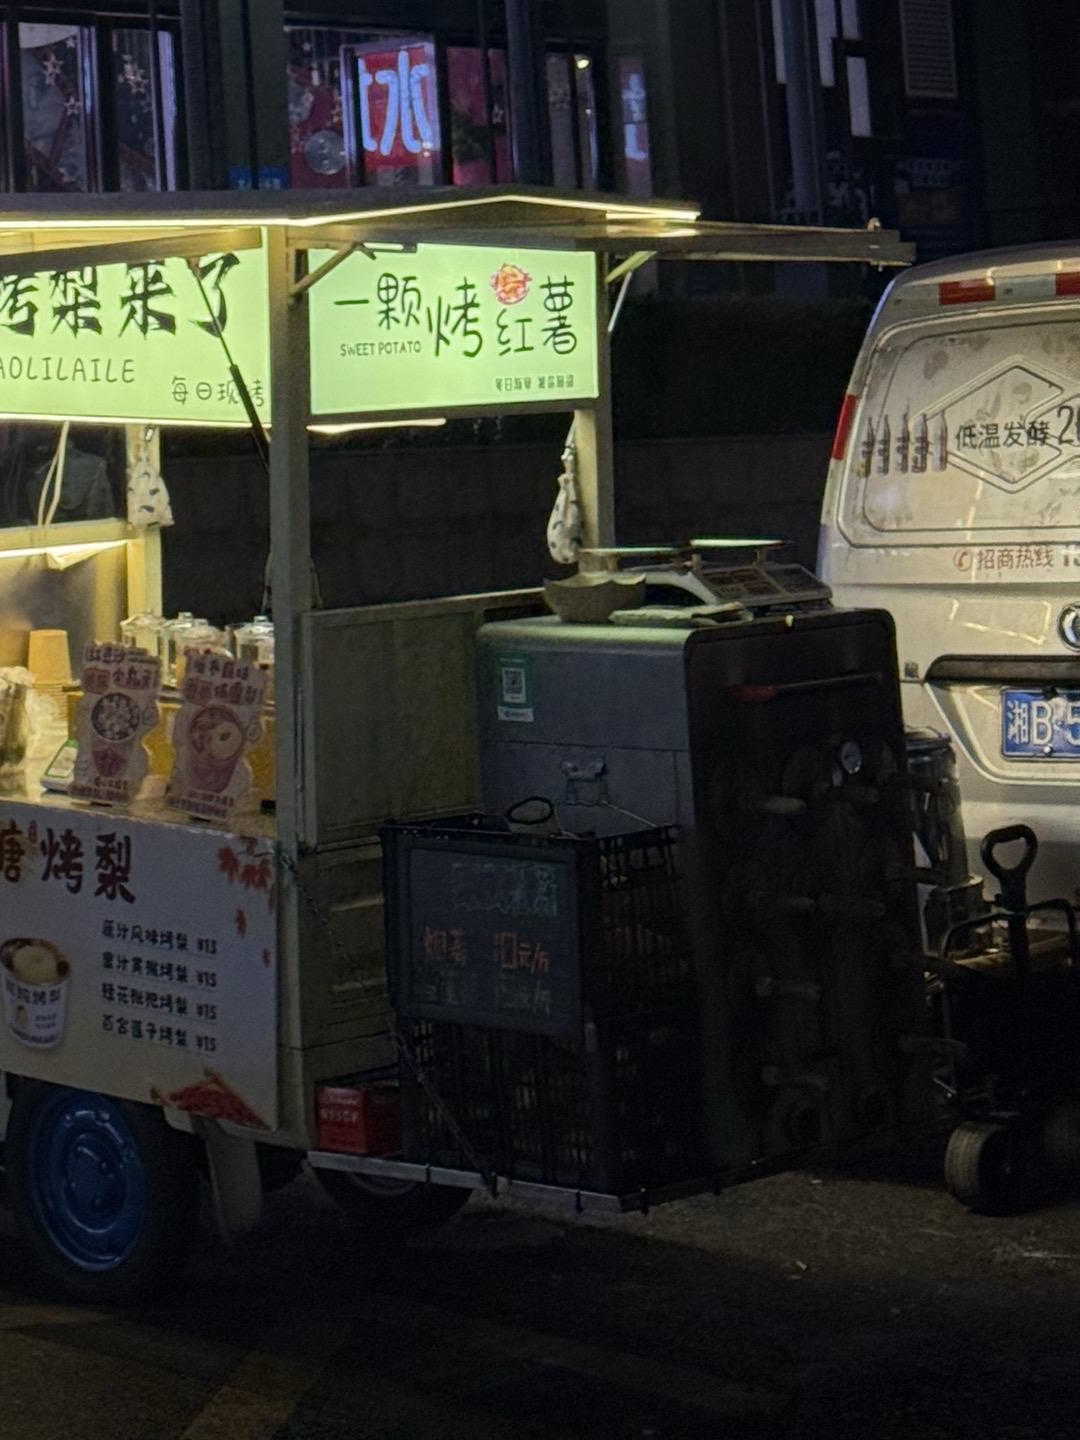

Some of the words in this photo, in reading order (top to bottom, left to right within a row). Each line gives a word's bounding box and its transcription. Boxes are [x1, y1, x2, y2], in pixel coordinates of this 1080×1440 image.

[333, 271, 578, 359] 一颗烤红薯
[339, 342, 376, 358] SWEET
[378, 340, 422, 356] POTATO
